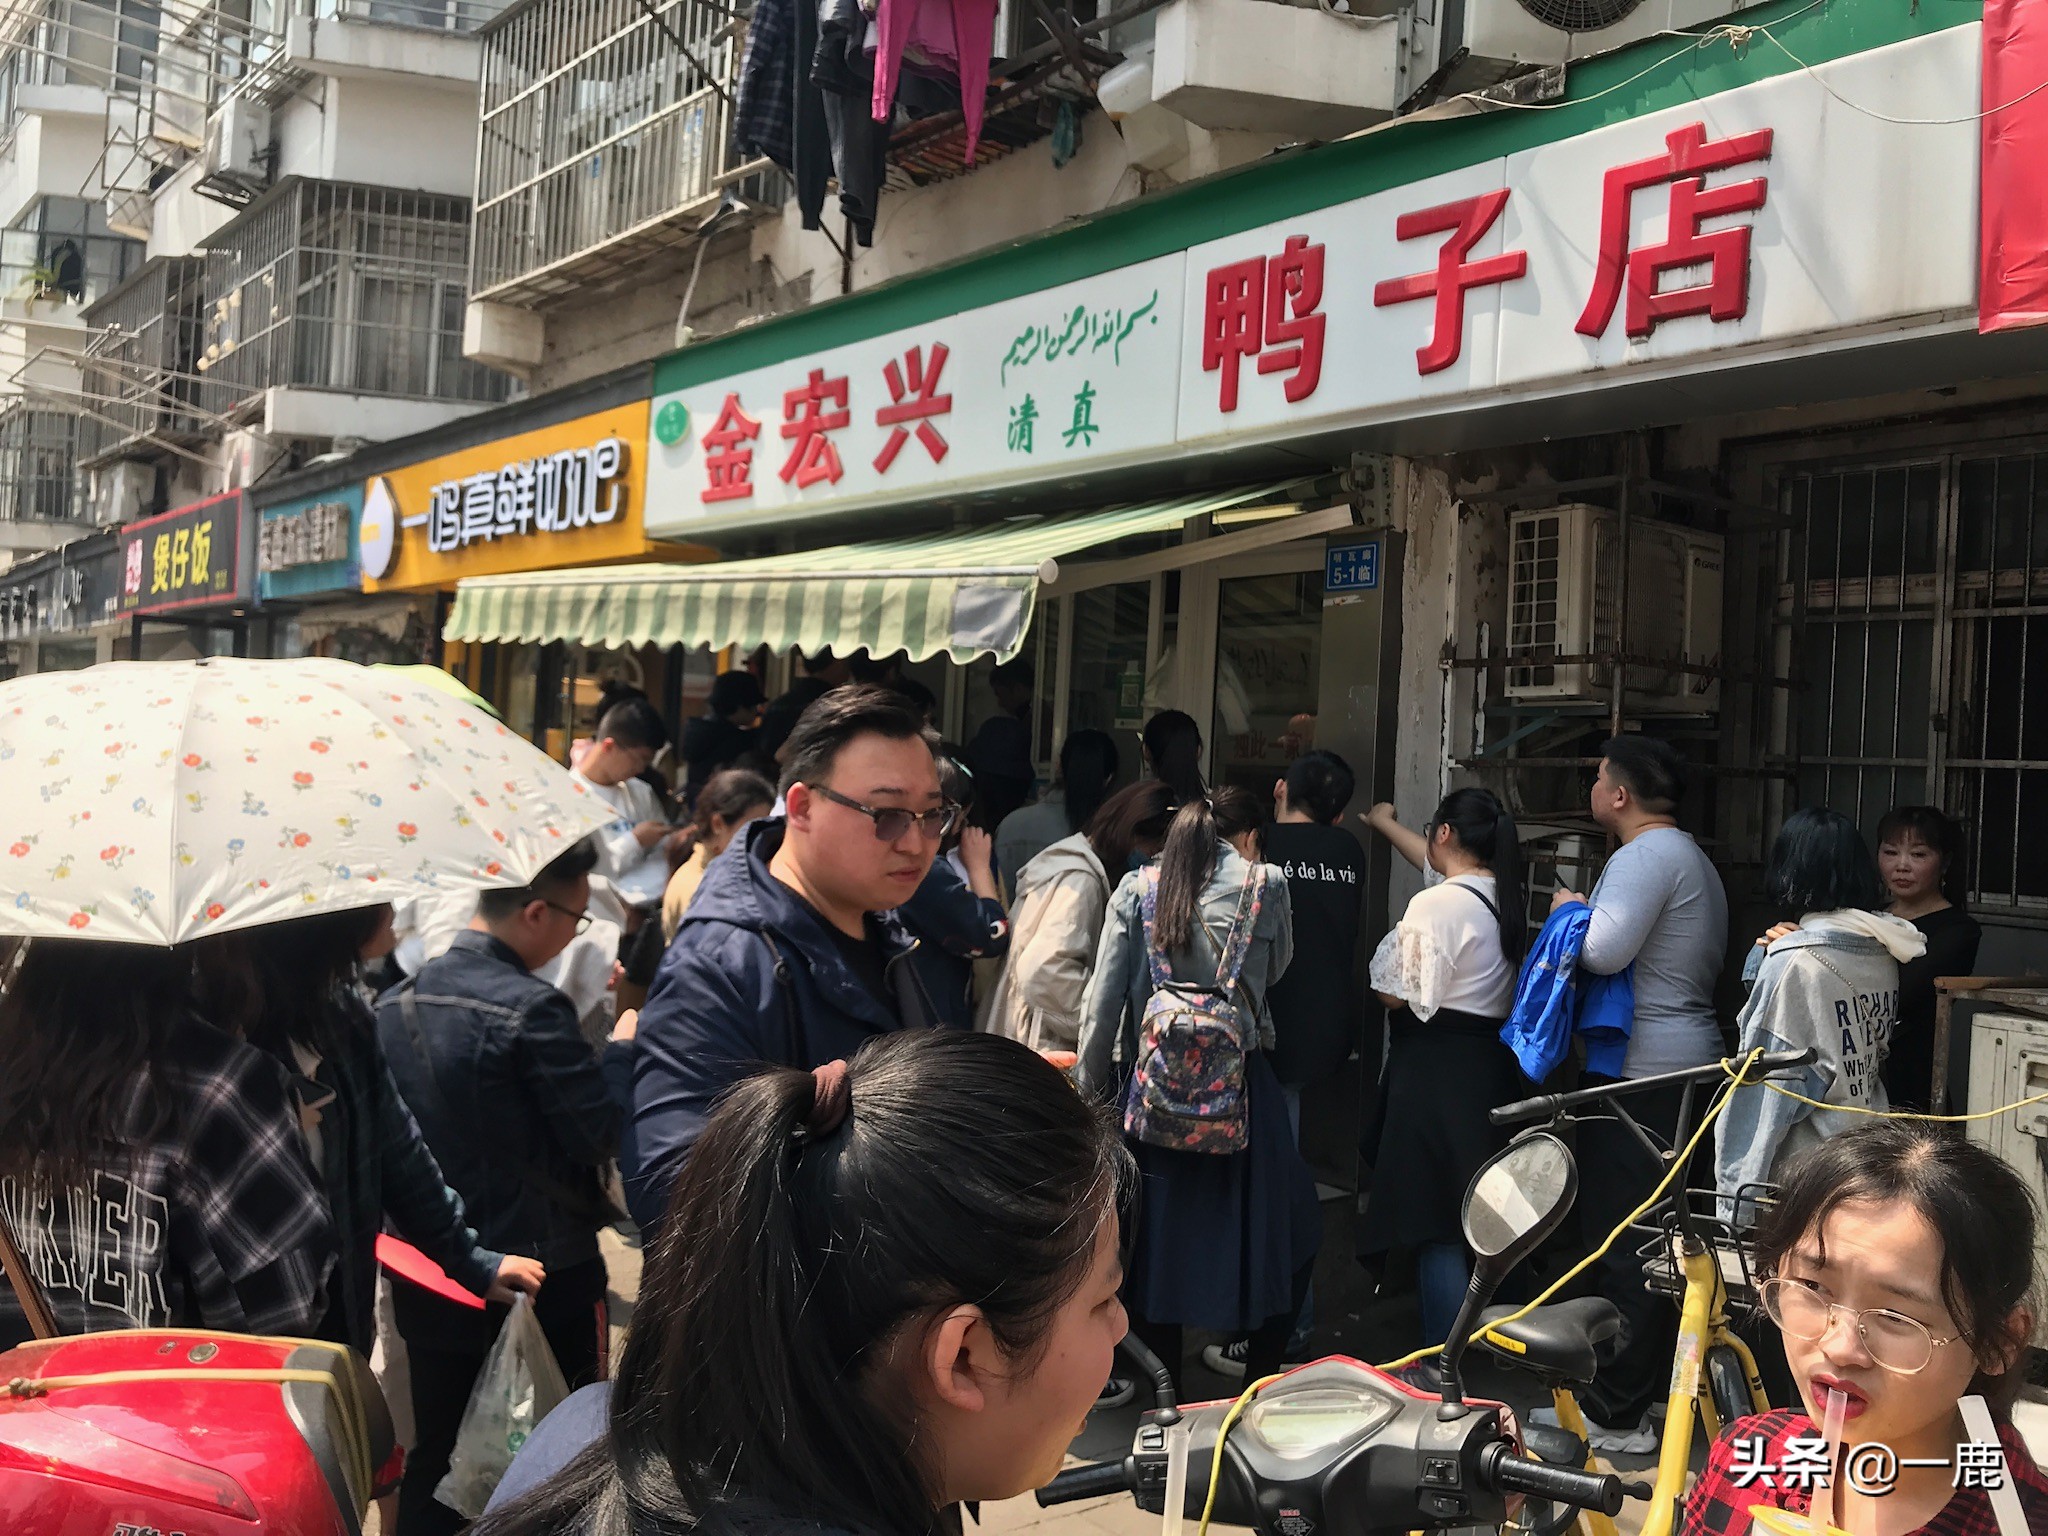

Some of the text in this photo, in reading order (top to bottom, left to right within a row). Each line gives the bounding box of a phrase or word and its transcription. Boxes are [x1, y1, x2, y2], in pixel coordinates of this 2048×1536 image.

[701, 121, 1774, 503] 金宏兴 鸭子店
[1007, 373, 1099, 454] 清真
[150, 520, 213, 594] 煲仔饭
[1333, 565, 1370, 584] 5-1临
[1298, 861, 1316, 880] de
[1319, 862, 1336, 882] la
[1850, 1079, 1863, 1097] of
